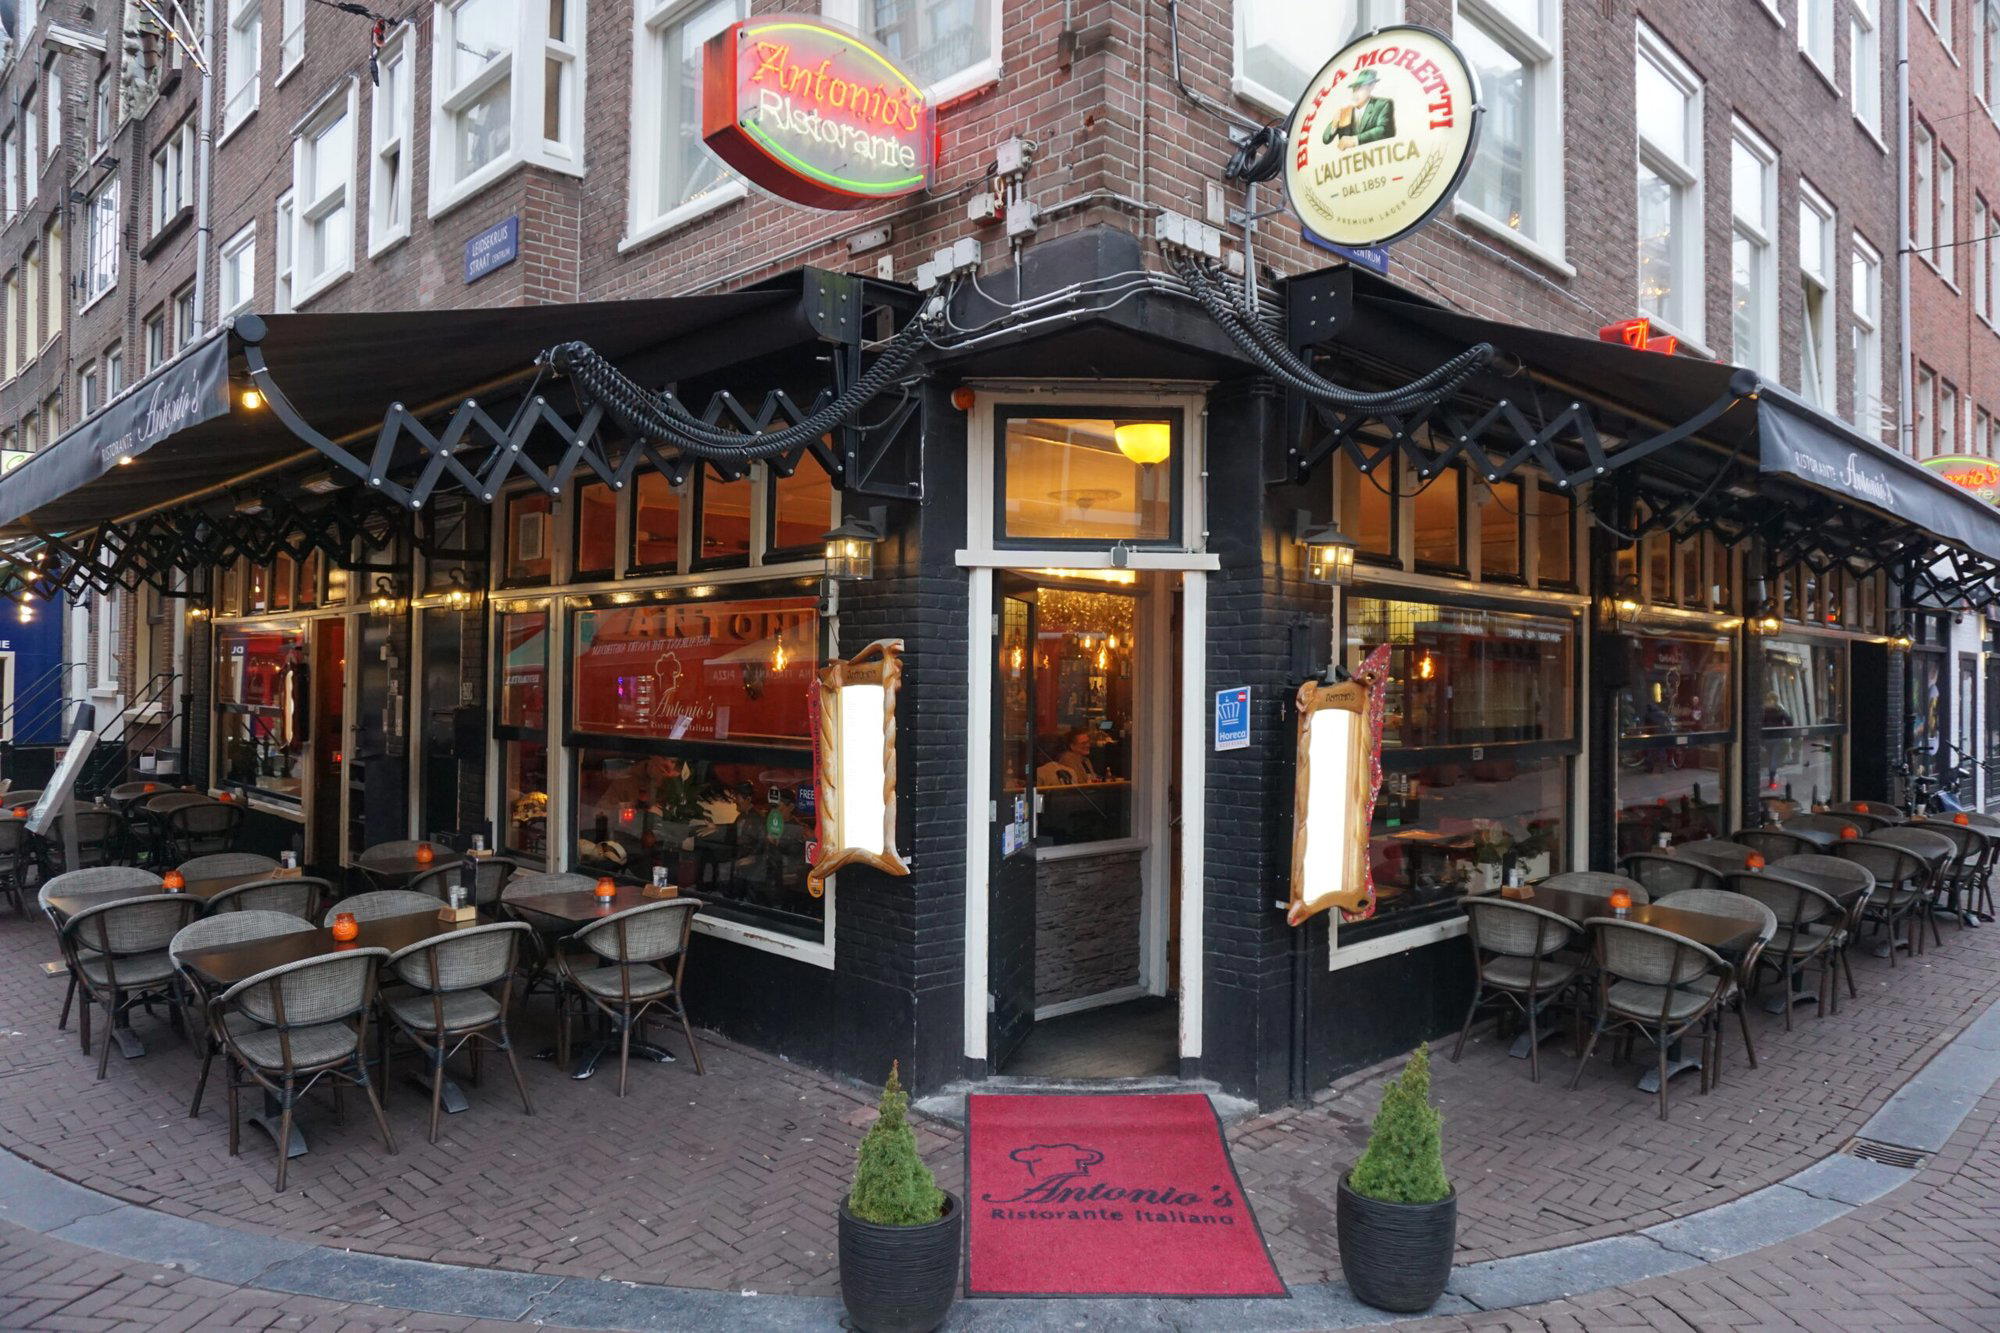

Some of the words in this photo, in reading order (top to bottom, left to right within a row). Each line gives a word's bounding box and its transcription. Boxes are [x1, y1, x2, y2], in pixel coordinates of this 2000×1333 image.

[751, 40, 921, 131] Antonio's
[1297, 68, 1348, 172] BIRRA
[1353, 46, 1454, 131] MORETTI
[1315, 140, 1421, 186] L'AUTENTICA
[1342, 183, 1361, 198] DAL
[1362, 176, 1388, 192] 1859
[469, 252, 491, 276] STRAAT
[137, 368, 201, 442] Antonio's
[1839, 452, 1894, 505] Antonio's
[1219, 730, 1247, 742] Horeca
[982, 1172, 1235, 1208] Antonio's
[990, 1208, 1124, 1222] Ristorante
[1135, 1210, 1235, 1226] Italiano
